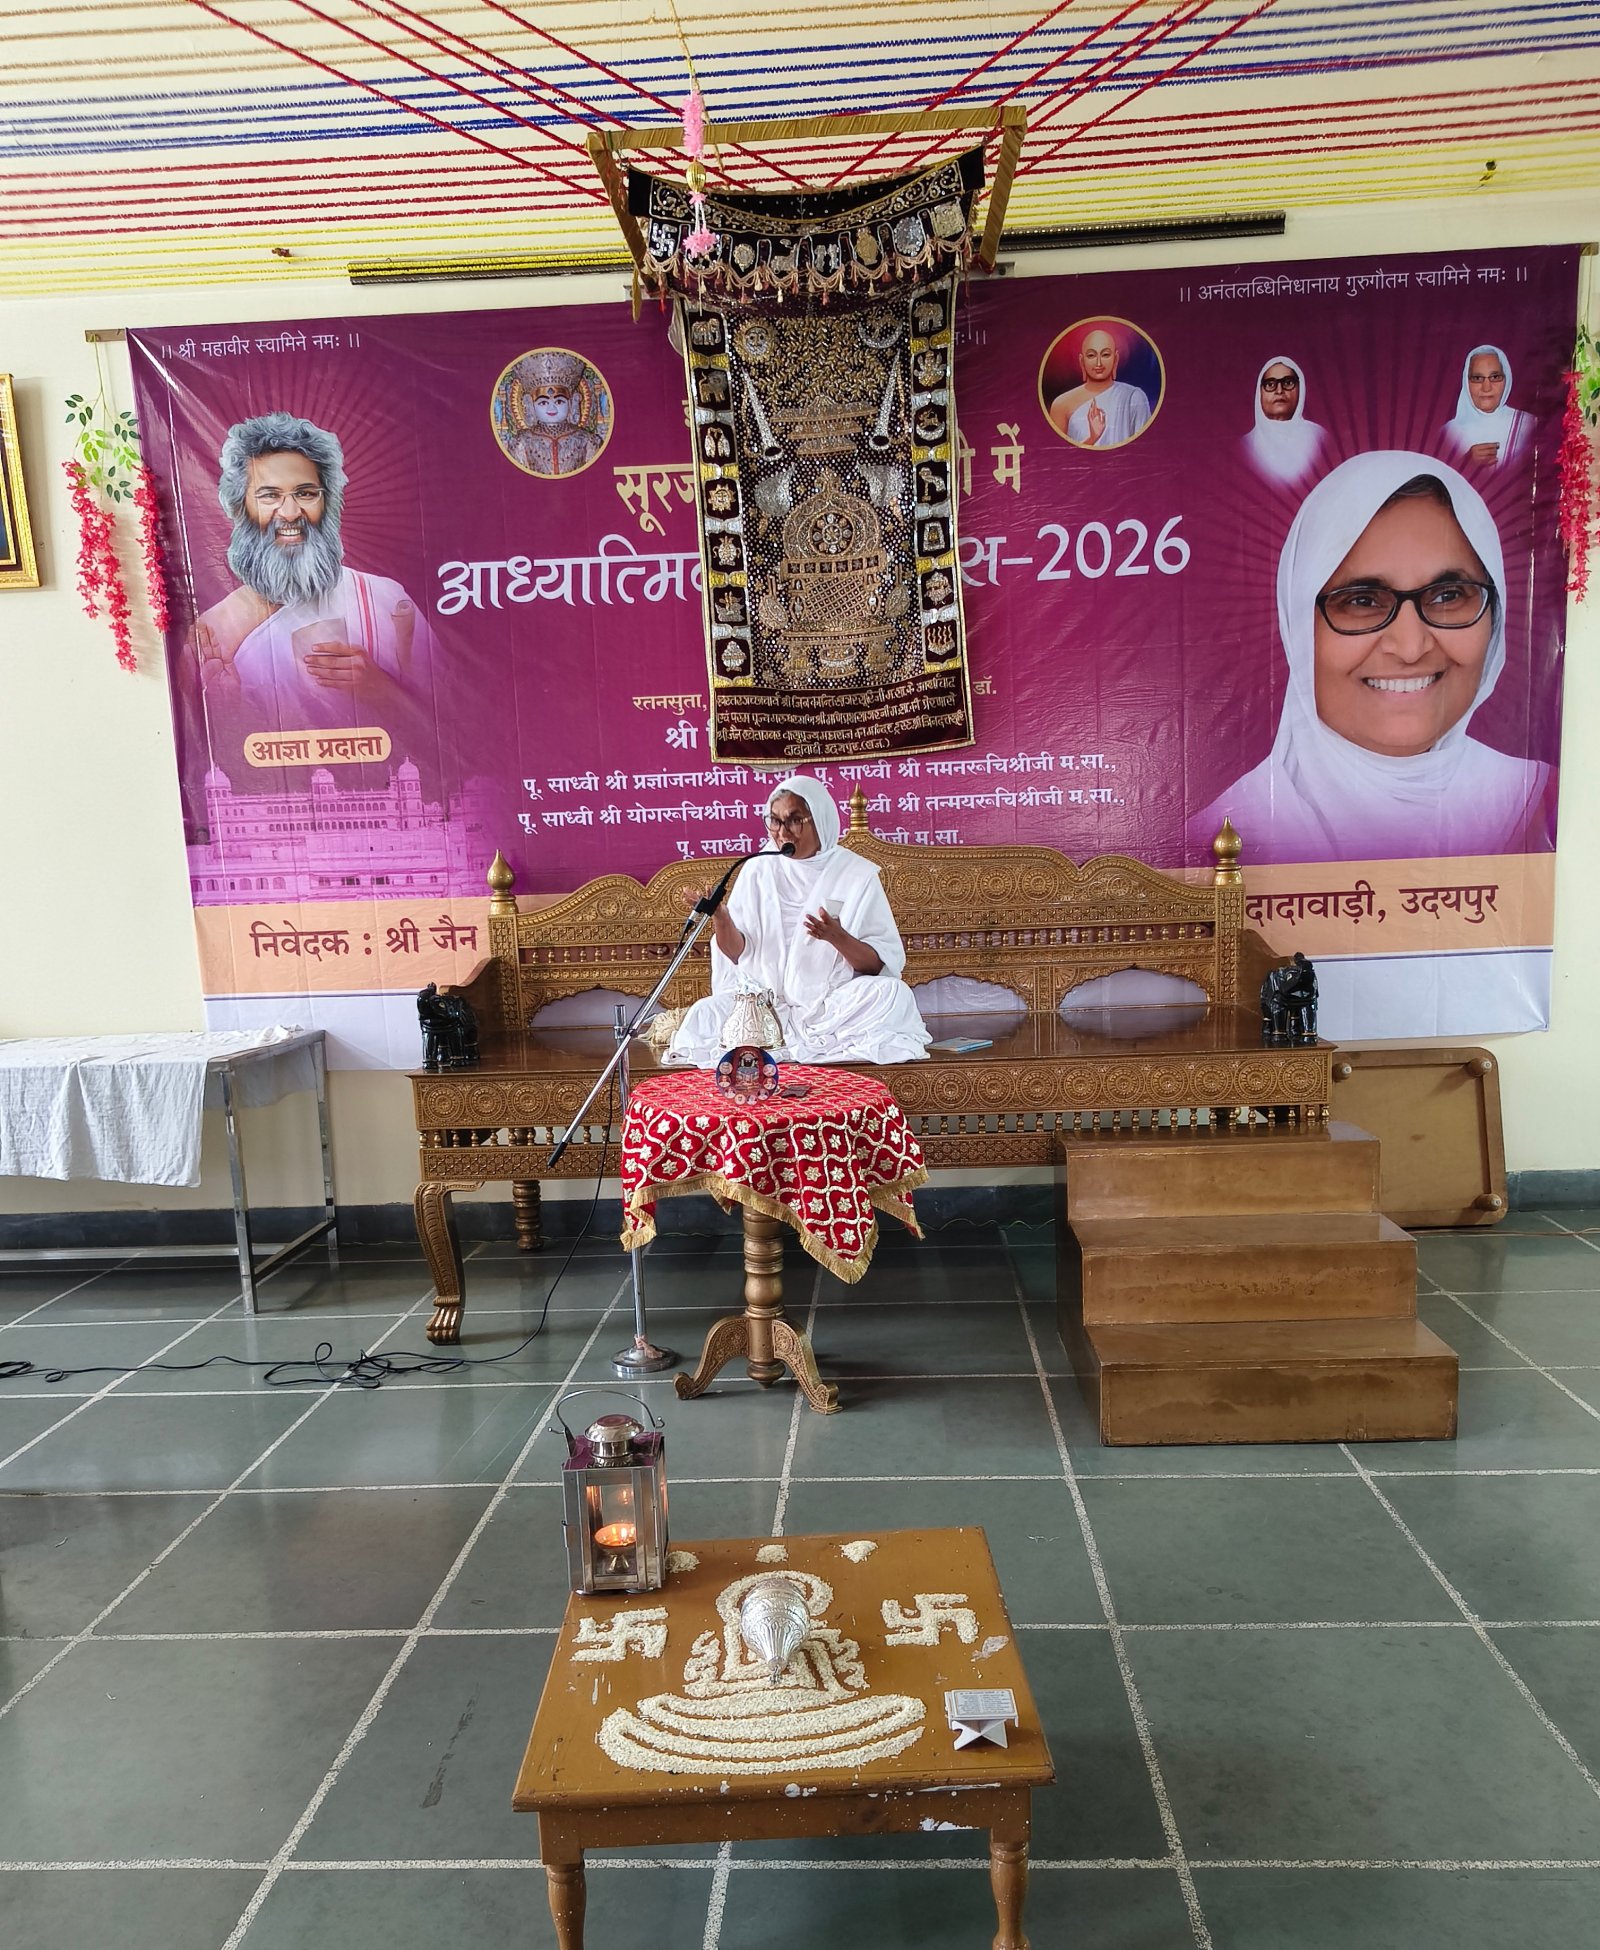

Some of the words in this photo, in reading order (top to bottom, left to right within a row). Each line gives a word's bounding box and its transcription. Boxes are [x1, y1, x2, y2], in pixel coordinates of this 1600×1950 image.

[1198, 276, 1340, 300] अनंतलब्धिनिधानाय
[1347, 268, 1409, 297] गुरुगौतम
[1416, 264, 1470, 288] स्वामिने
[1477, 267, 1506, 284] नमः
[179, 338, 196, 358] श्री
[201, 335, 250, 357] महावीर
[255, 330, 306, 353] स्वामिने
[312, 334, 340, 349] नमः
[991, 423, 1025, 494] में
[958, 515, 1191, 587] स-2026
[632, 694, 708, 716] रतनसुता,
[972, 675, 997, 695] डॉ.
[252, 739, 309, 761] आज्ञा
[316, 735, 383, 760] प्रदाता
[665, 719, 698, 750] श्री
[523, 777, 543, 800] पू.
[547, 771, 600, 793] साध्वी
[605, 770, 628, 792] श्री
[839, 759, 892, 782] साध्वी
[897, 758, 921, 780] श्री
[518, 812, 538, 835] पू.
[542, 805, 593, 828] साध्वी
[599, 804, 622, 825] श्री
[897, 792, 920, 812] श्री
[701, 833, 753, 855] साध्वी
[1398, 884, 1499, 923] उदयपुर
[249, 920, 349, 962] निवेदक
[386, 917, 419, 954] श्री
[429, 914, 478, 952] जैन
